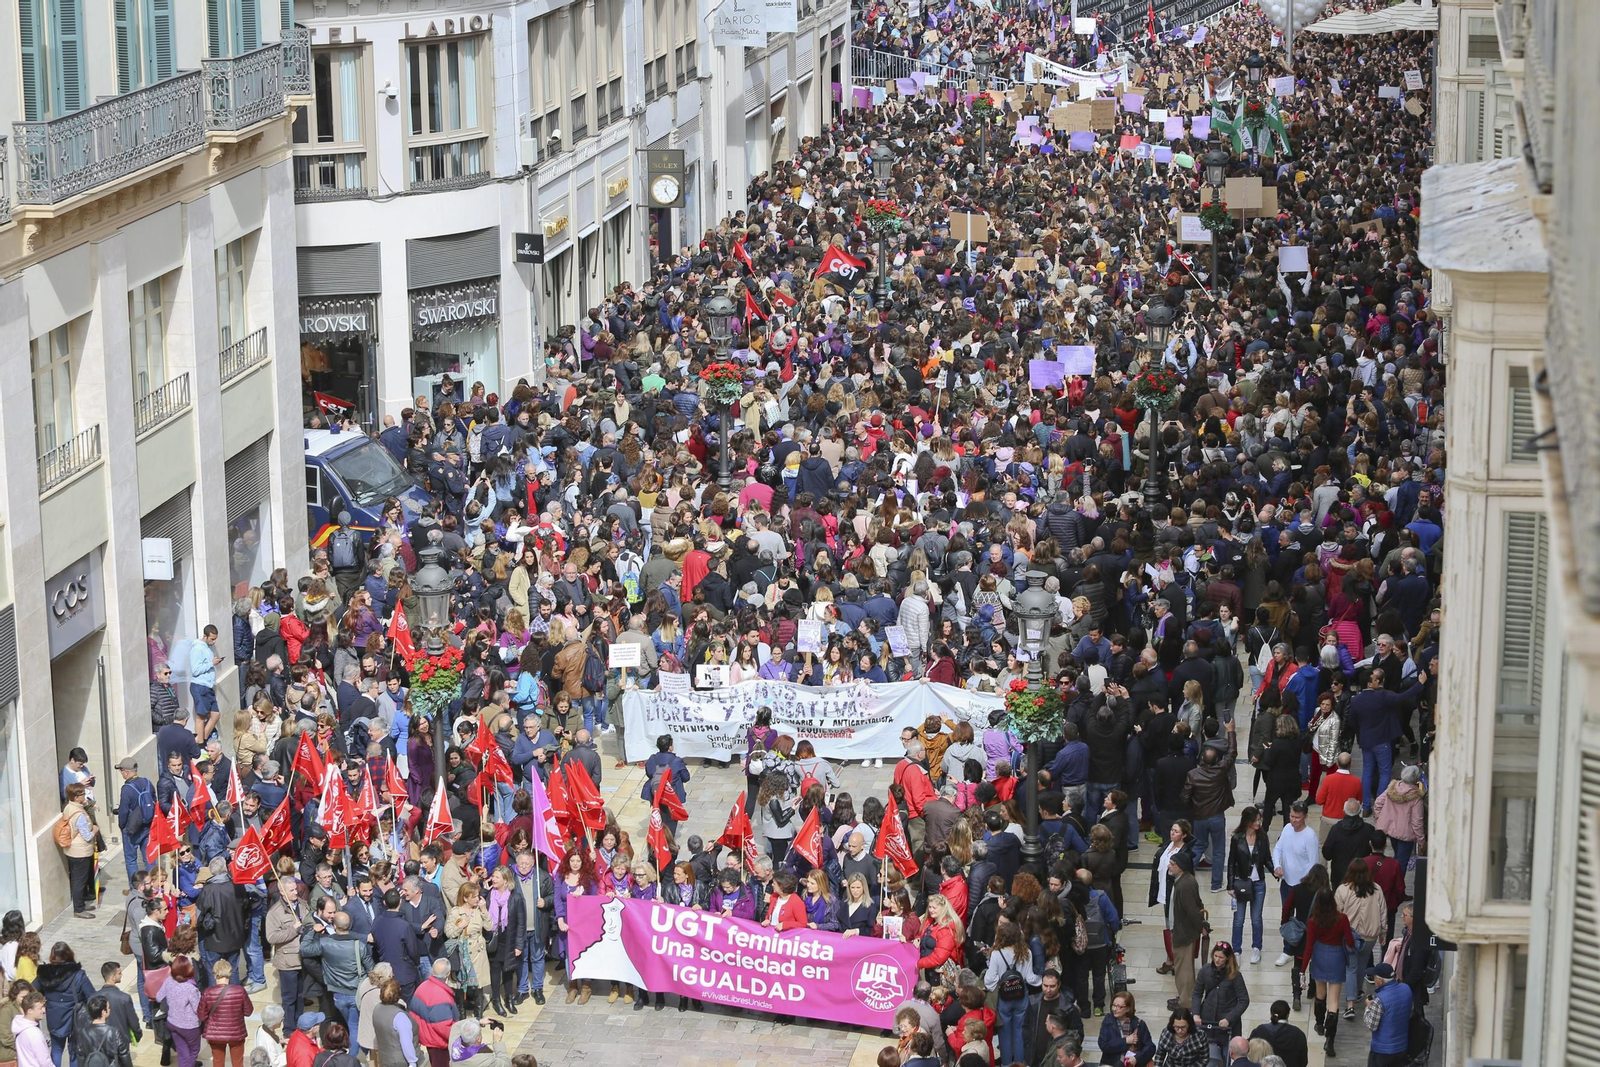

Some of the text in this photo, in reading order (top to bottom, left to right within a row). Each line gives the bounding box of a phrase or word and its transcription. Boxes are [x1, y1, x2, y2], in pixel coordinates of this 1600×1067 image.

[404, 12, 493, 40] LARIOS
[719, 14, 761, 26] LARIOS
[830, 258, 859, 281] CGT
[418, 298, 496, 327] SWAROVSKI
[319, 399, 348, 415] CGT
[52, 574, 88, 616] COS
[645, 704, 704, 723] LIBRES
[723, 704, 735, 721] Y
[668, 723, 721, 733] FEMINISMO
[650, 905, 835, 962] UGT feminista
[651, 935, 830, 981] Una sociedad en
[672, 964, 806, 1002] IGUALDAD
[861, 961, 899, 985] UGT
[701, 991, 773, 1010] #VivasLibresUnidas
[863, 996, 894, 1010] MÁLAGA
